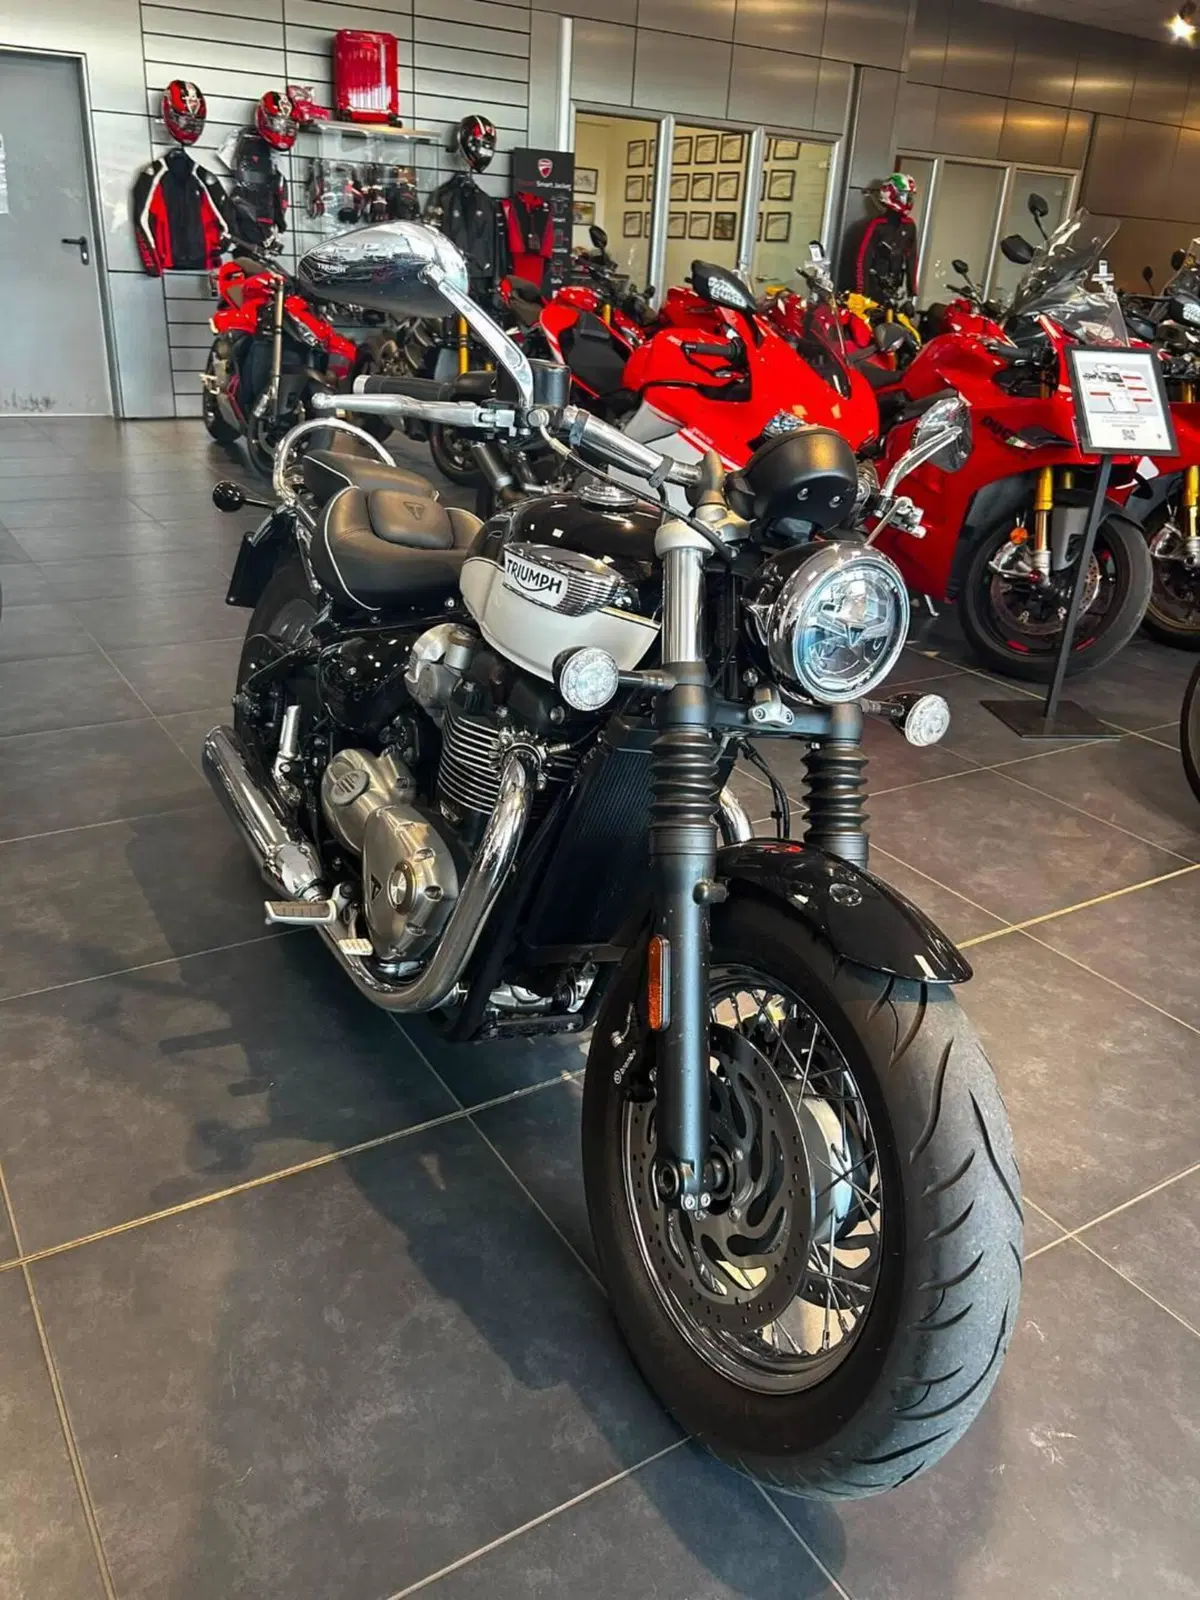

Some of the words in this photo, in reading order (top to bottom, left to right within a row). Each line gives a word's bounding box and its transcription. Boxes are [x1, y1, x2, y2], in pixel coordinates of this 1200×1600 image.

[316, 262, 348, 274] TRIUMPH
[506, 559, 563, 594] TRIUMPH
[620, 1049, 637, 1075] brembo
